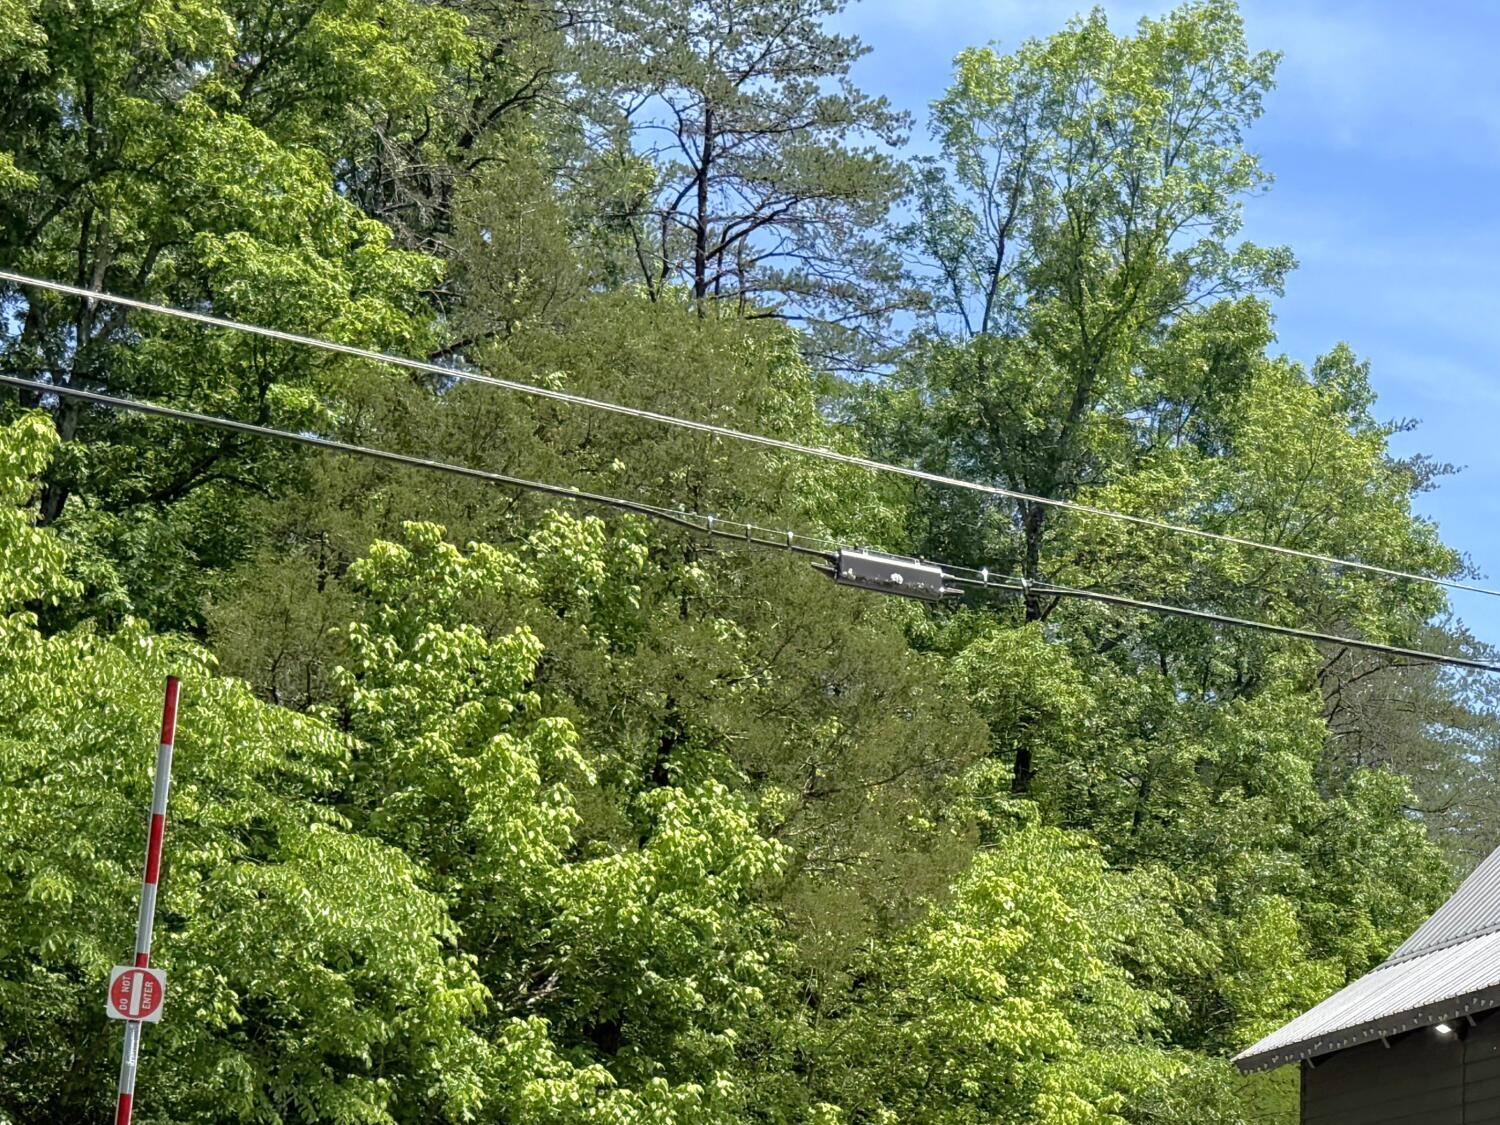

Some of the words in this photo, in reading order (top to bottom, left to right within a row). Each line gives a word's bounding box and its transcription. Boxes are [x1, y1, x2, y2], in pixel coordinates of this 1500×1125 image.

[121, 976, 132, 993] NOT
[142, 981, 154, 1010] ENTER
[118, 998, 130, 1011] DO
